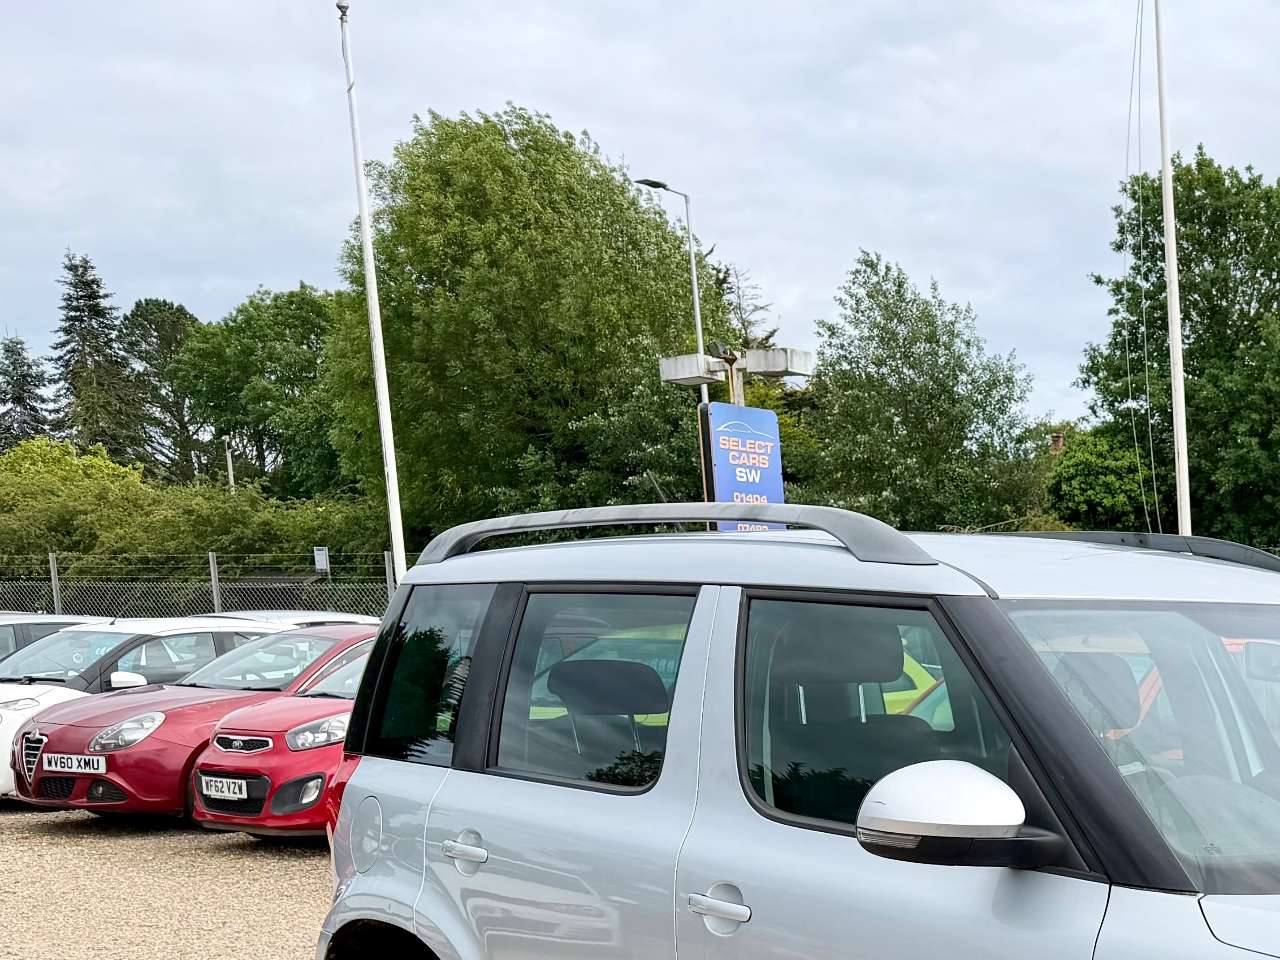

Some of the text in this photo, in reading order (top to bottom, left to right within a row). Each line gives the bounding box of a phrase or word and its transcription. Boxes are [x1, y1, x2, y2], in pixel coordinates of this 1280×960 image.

[719, 436, 774, 454] SELECT
[729, 451, 769, 468] CARS
[735, 467, 761, 483] SW
[47, 755, 100, 771] WV60 XMU
[204, 777, 244, 795] WF62 VZW
